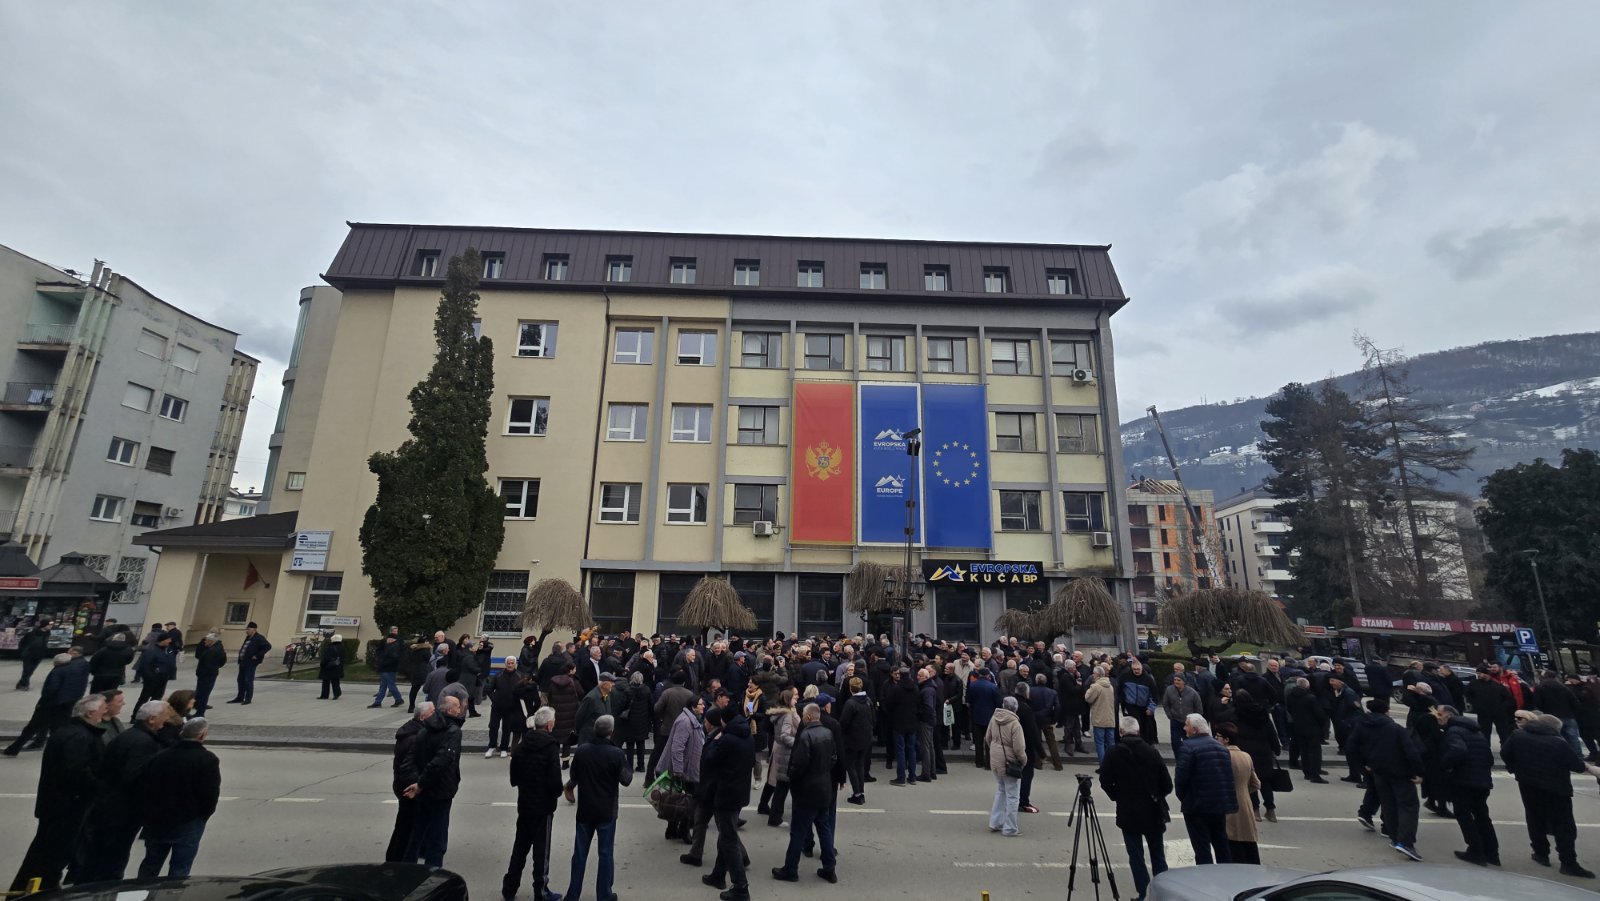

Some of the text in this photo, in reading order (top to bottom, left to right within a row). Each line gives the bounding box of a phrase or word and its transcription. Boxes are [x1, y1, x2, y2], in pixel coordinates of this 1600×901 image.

[970, 563, 1038, 574] EVROPSKA
[1361, 618, 1394, 628] ŠTAMPA
[1413, 619, 1452, 632] ŠTAMPA
[1470, 622, 1517, 633] ŠTAMPA
[1519, 630, 1531, 643] P
